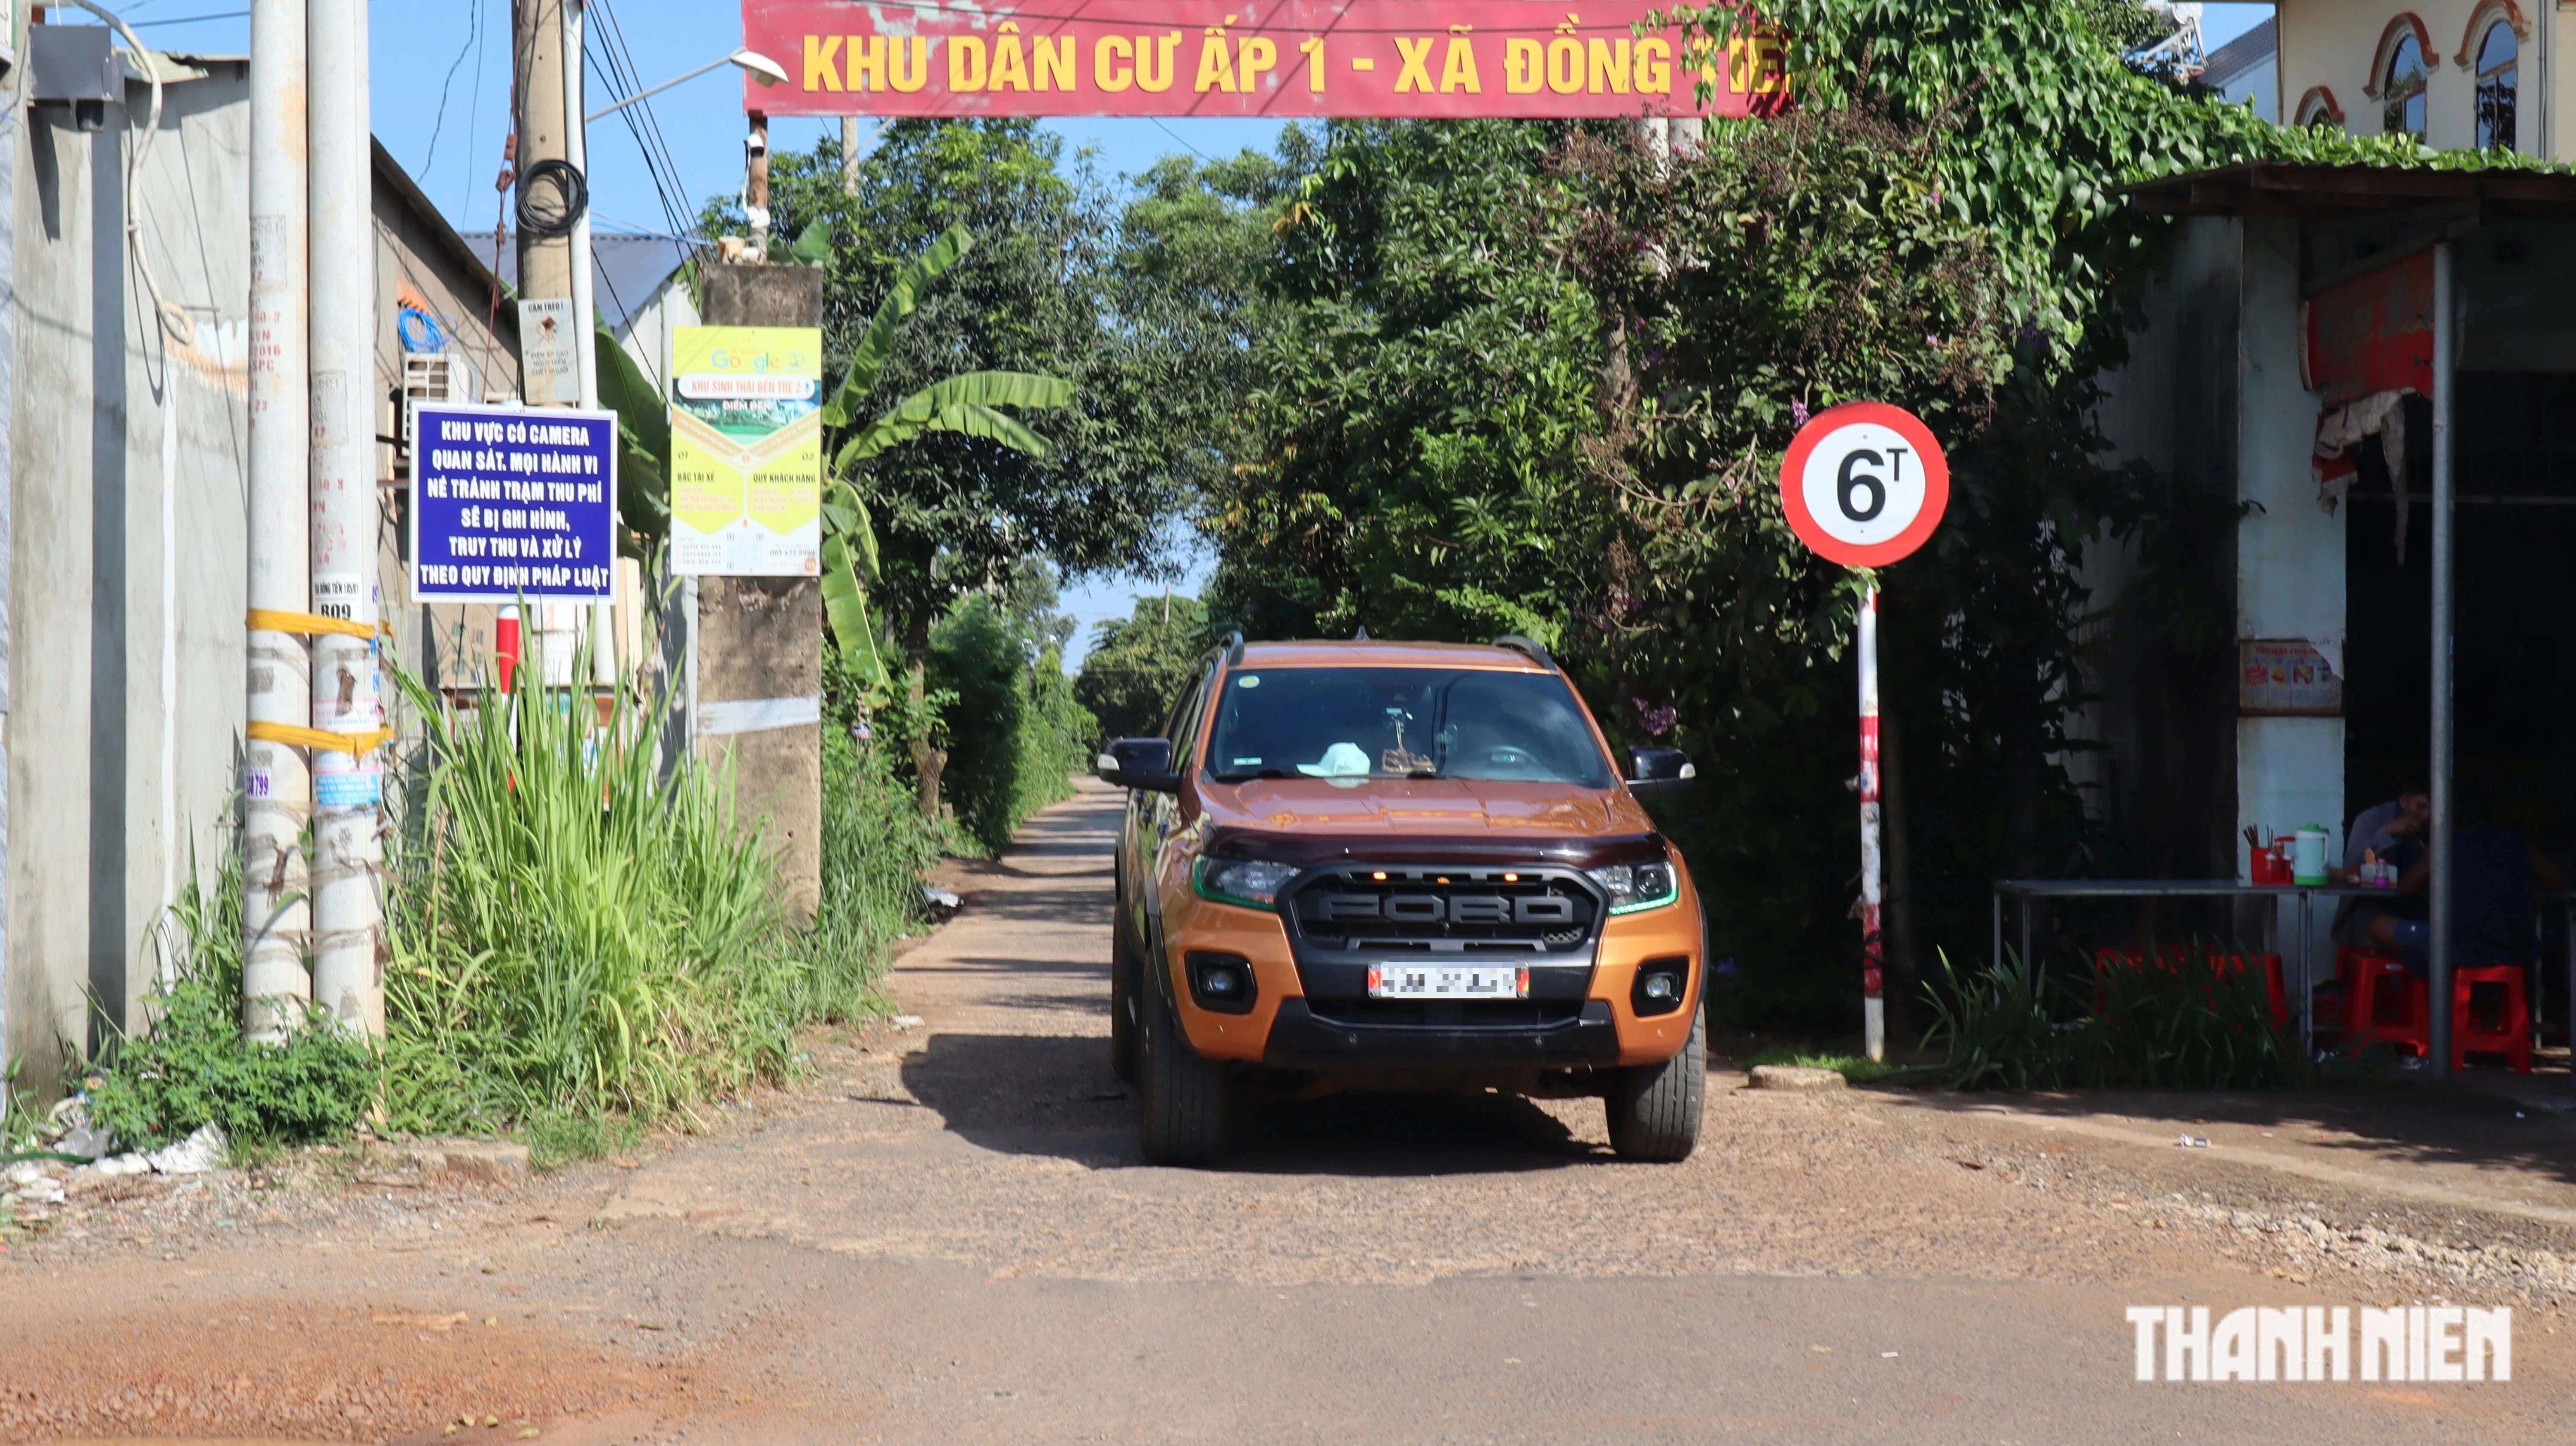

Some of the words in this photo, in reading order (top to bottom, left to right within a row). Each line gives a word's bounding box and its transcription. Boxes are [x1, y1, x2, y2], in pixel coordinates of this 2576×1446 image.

[803, 35, 927, 93] KHU
[948, 21, 1076, 93] DÂN
[1094, 30, 1182, 92] CƯ
[1194, 15, 1277, 93] ẤP
[1300, 37, 1325, 93] 1
[1352, 58, 1373, 71] -
[1393, 24, 1482, 94] XÃ
[1504, 13, 1671, 94] ĐỒNG
[692, 379, 709, 393] KHU
[712, 379, 733, 394] SINH
[736, 378, 755, 394] THÁI
[757, 377, 775, 394] BẾN
[778, 380, 793, 394] TRE
[441, 420, 471, 442] KHU
[474, 421, 503, 446] VỰC
[507, 421, 526, 444] CÓ
[530, 425, 589, 447] CAMERA
[432, 450, 472, 471] QUAN
[476, 448, 506, 471] SÁT.
[510, 453, 538, 476] MỌI
[541, 450, 580, 474] HÀNH
[583, 455, 598, 475] VI
[428, 475, 447, 498] NÉ
[450, 476, 500, 500] TRÁNH
[503, 480, 544, 504] TRẠM
[547, 482, 574, 502] THU
[577, 481, 602, 503] PHÍ
[769, 472, 794, 484] KHÁCH
[461, 505, 480, 528] SẼ
[484, 508, 499, 532] BỊ
[502, 509, 526, 529] GHI
[530, 507, 571, 532] HÌNH,
[449, 536, 487, 557] TRUY
[490, 537, 517, 558] THU
[520, 535, 539, 558] VÀ
[542, 534, 563, 558] XỬ
[565, 536, 582, 559] LÝ
[420, 565, 458, 585] THEO
[462, 565, 490, 587] QUY
[493, 566, 529, 589] ĐỊNH
[532, 564, 571, 586] PHÁP
[574, 564, 609, 591] LUẬT
[1319, 894, 1573, 923] FORD
